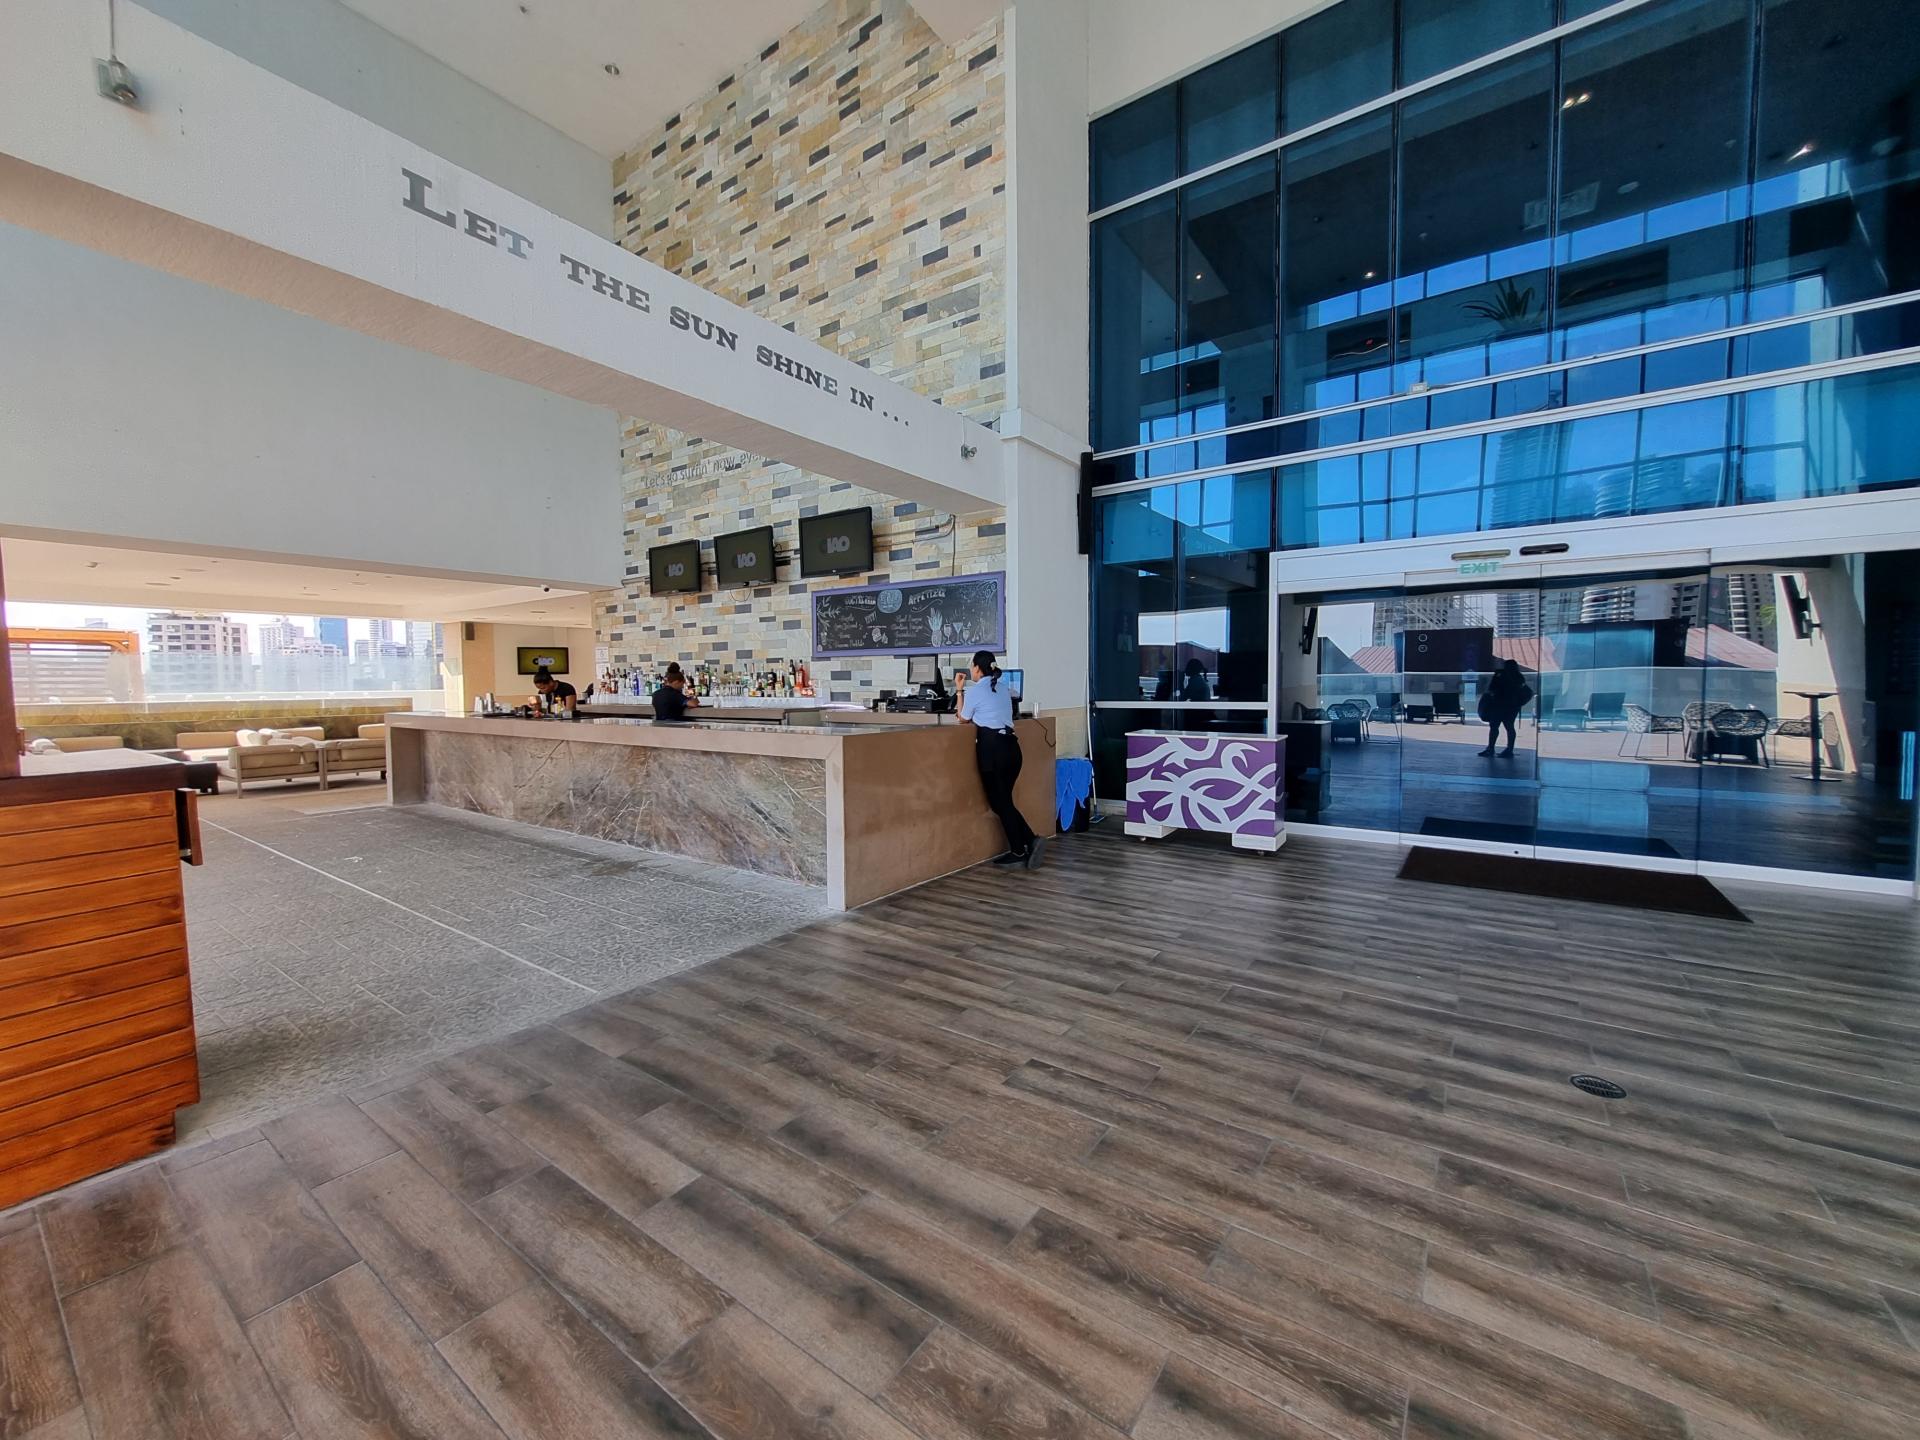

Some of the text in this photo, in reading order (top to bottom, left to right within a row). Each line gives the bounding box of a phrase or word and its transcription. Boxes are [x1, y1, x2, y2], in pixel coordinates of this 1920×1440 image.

[402, 167, 534, 260] LET
[560, 253, 650, 313] THE
[670, 305, 738, 352] SUN
[756, 344, 838, 396] SHINE
[667, 472, 679, 485] go
[1460, 561, 1500, 575] EXIT
